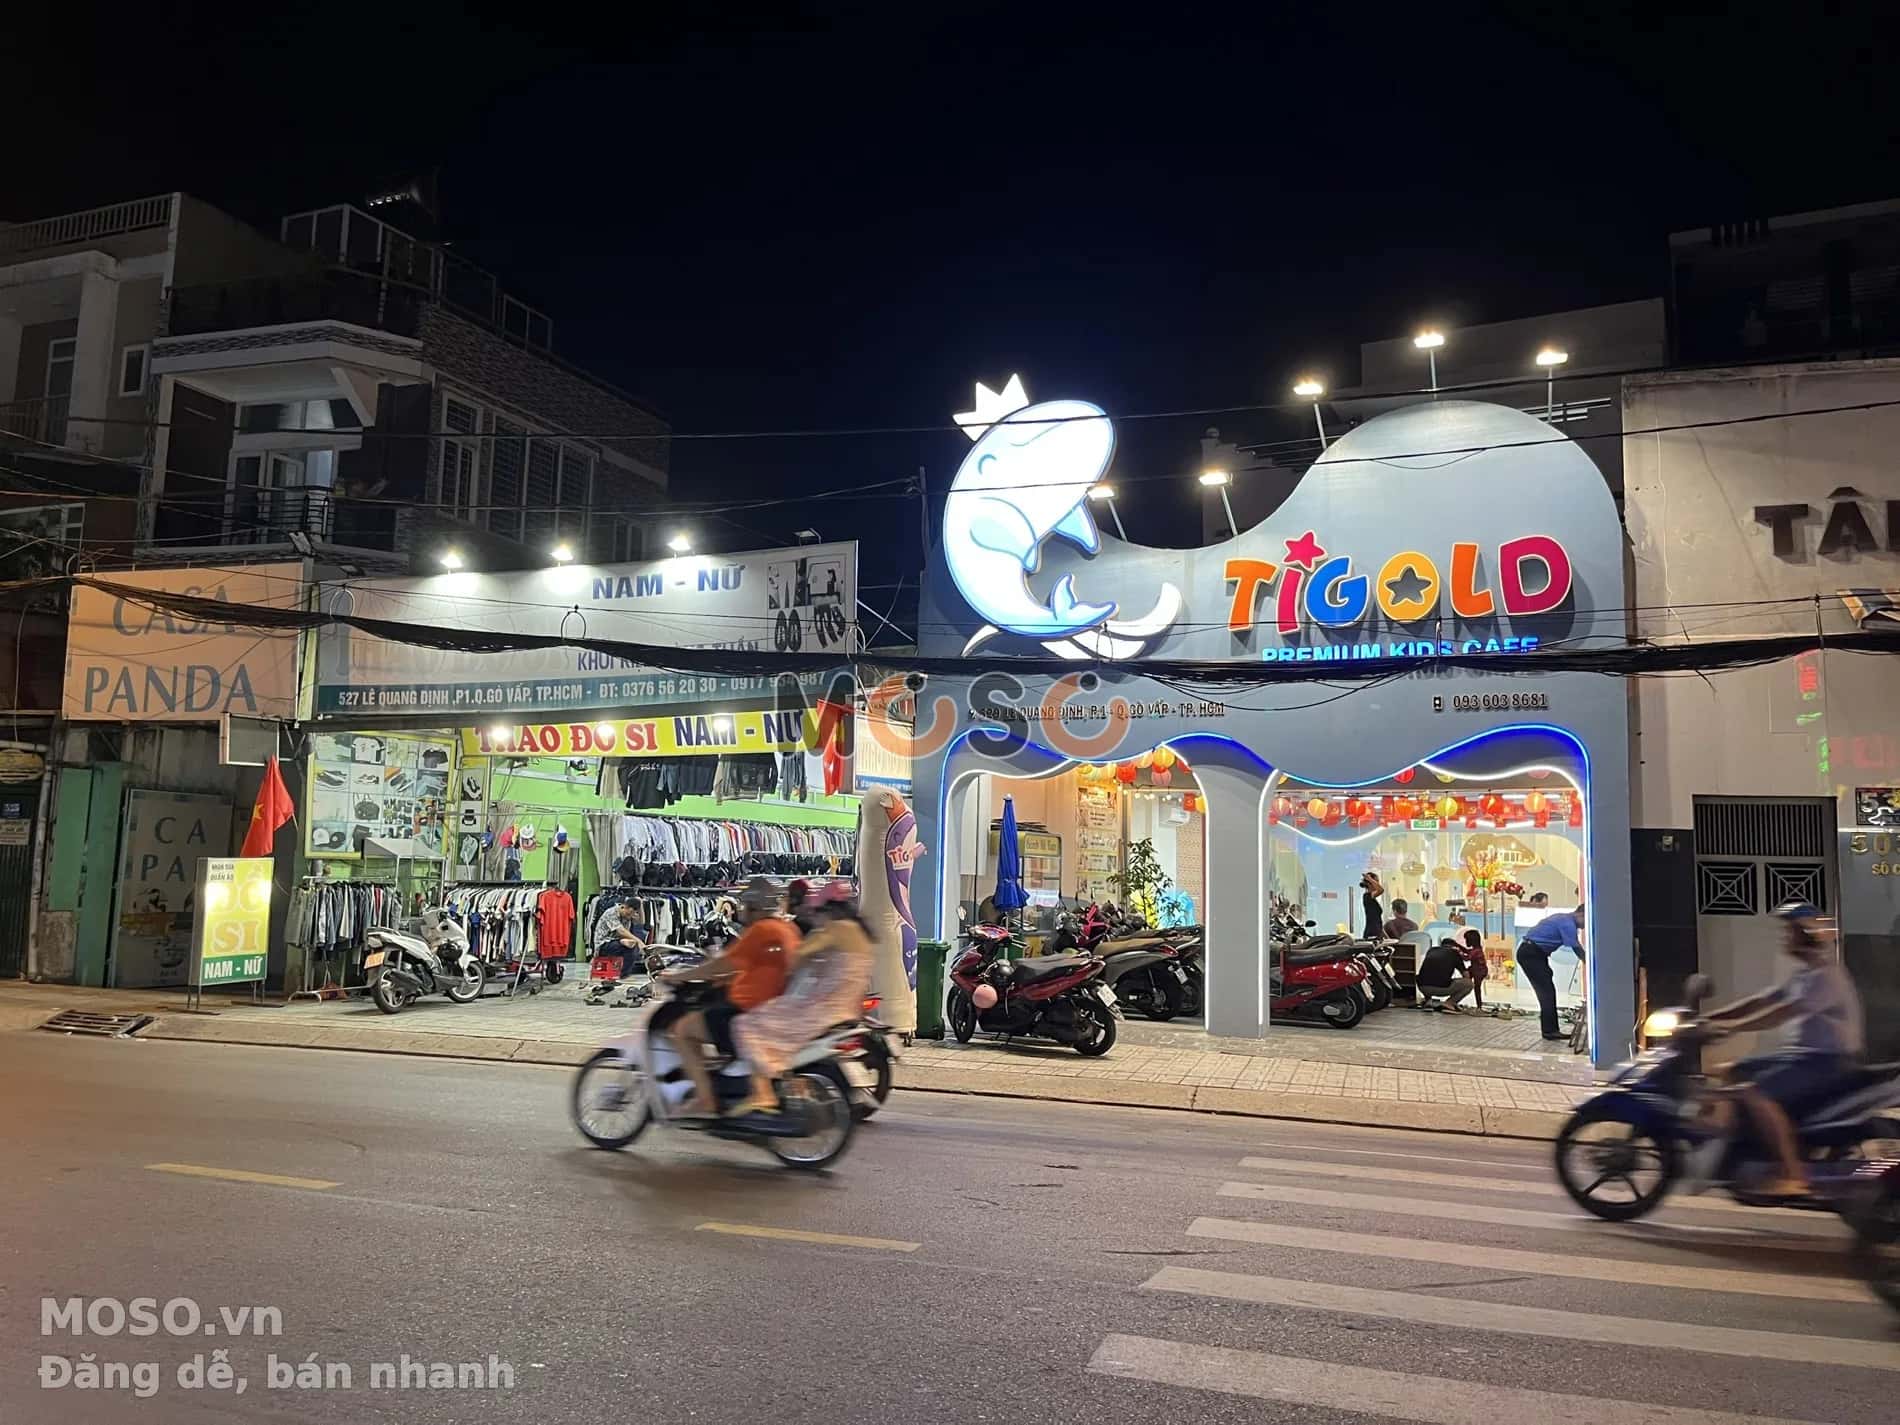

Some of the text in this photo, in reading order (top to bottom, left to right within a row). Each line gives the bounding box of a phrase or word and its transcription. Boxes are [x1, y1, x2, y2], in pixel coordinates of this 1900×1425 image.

[1754, 486, 1900, 556] TÂ
[592, 573, 663, 600] NAM
[697, 563, 745, 592] NỮ
[112, 584, 236, 636] CASA
[1262, 643, 1381, 662] PREMIUM
[1389, 640, 1452, 657] KIDS
[84, 663, 258, 713] PANDA
[339, 692, 359, 706] 527
[362, 688, 376, 706] LÊ
[379, 691, 418, 706] QUANG
[536, 684, 583, 701] TP.HCM
[622, 681, 655, 697] 0376
[658, 680, 675, 695] 56
[679, 678, 696, 694] 20
[700, 676, 717, 692] 30
[1453, 693, 1547, 709] 093 603 8681
[1021, 705, 1055, 719] QUANG
[1149, 698, 1168, 715] VẤP
[625, 723, 658, 751] SI
[674, 716, 737, 746] NAM
[155, 816, 206, 844] CA
[213, 921, 260, 952] SI
[204, 961, 233, 979] NAM
[244, 956, 263, 976] NỮ
